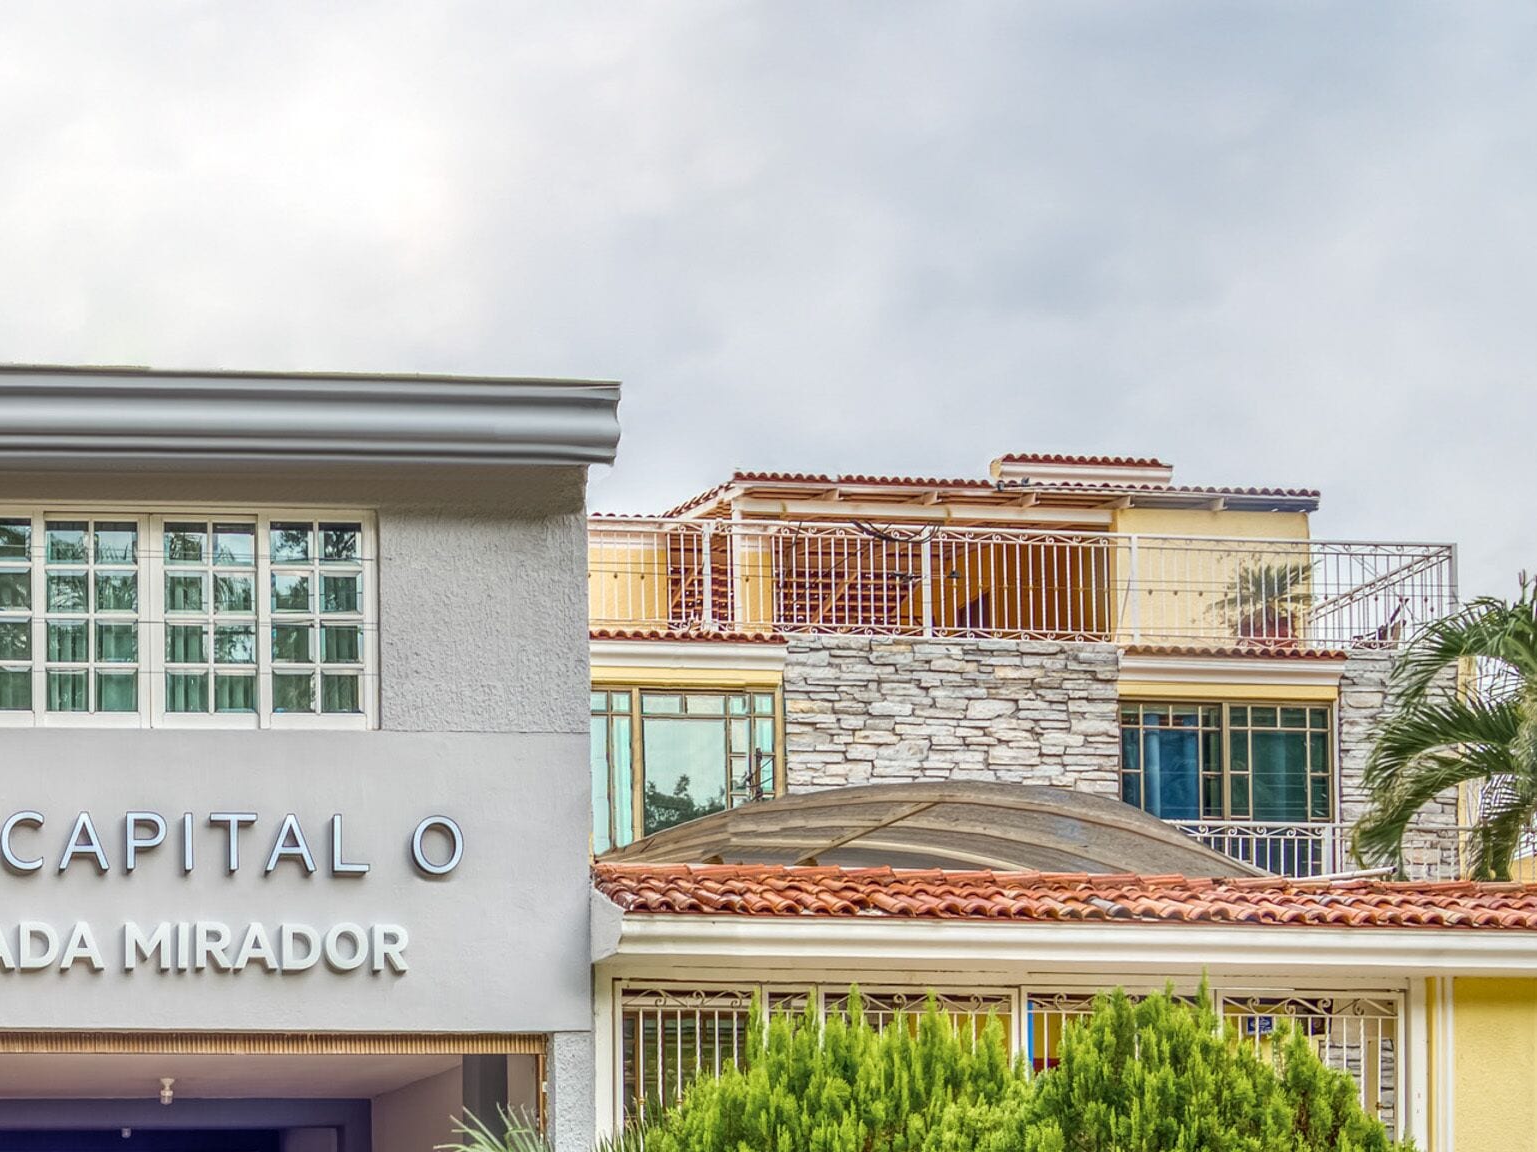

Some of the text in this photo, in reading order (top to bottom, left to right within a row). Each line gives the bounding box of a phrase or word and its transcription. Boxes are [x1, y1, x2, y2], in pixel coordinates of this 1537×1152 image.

[0, 810, 465, 877] CAPITAL O
[122, 921, 410, 975] MIRADOR
